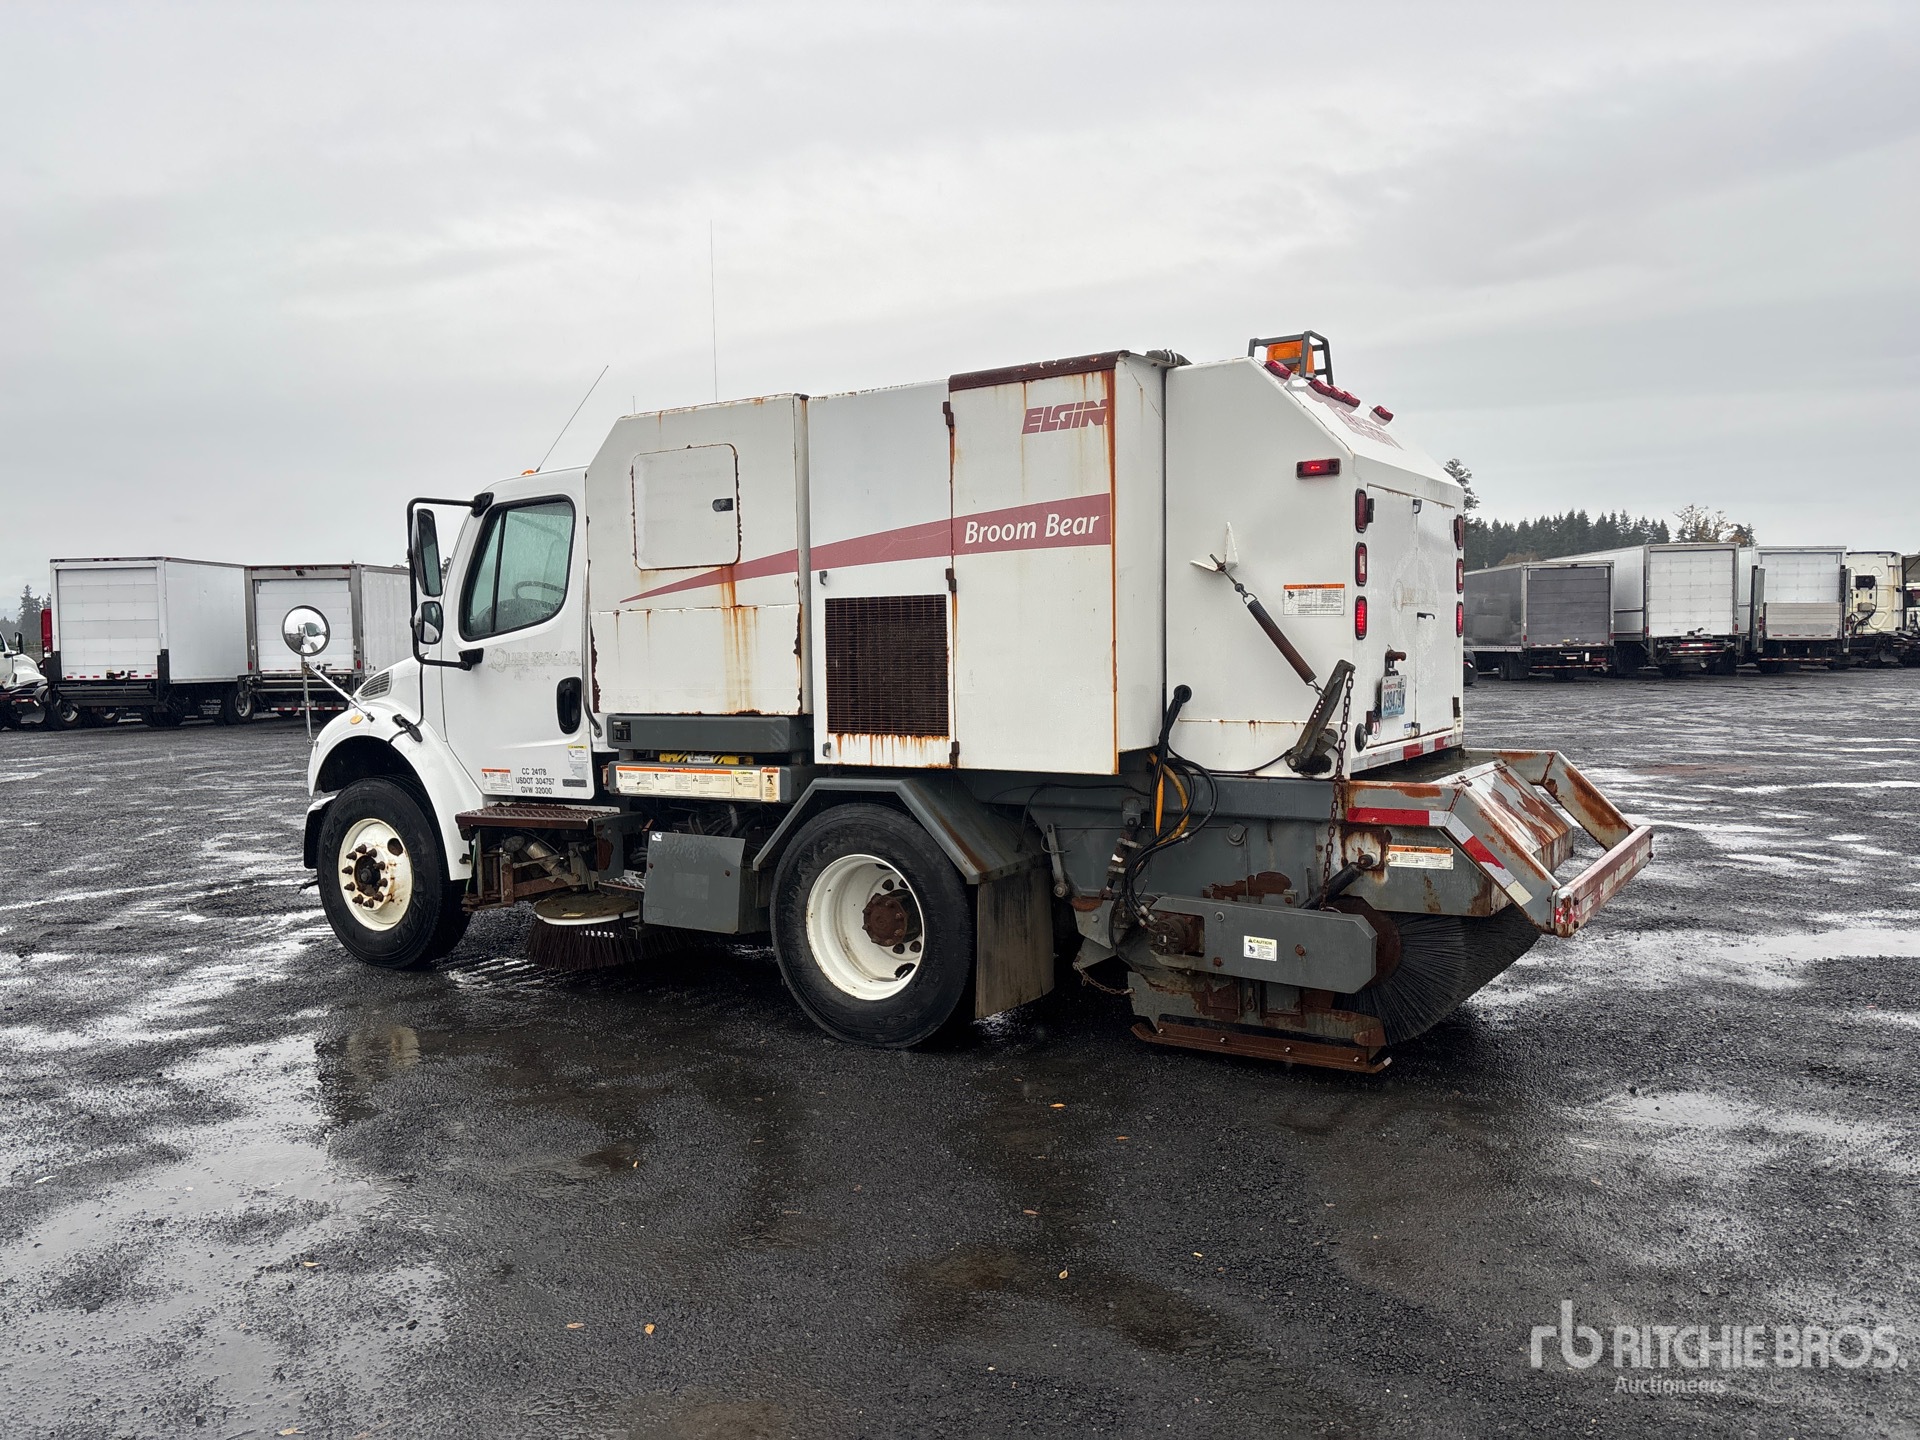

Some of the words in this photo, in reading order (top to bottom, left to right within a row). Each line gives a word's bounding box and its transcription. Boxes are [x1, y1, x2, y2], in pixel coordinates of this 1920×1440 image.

[1022, 398, 1109, 435] ELGIN
[964, 521, 1037, 545] Broom
[1045, 513, 1100, 538] Bear
[521, 767, 530, 775] CC
[531, 767, 547, 776] 24178
[515, 776, 533, 785] USDOT
[535, 777, 555, 786] 304757
[520, 786, 533, 794] GVW
[535, 786, 553, 795] 32000
